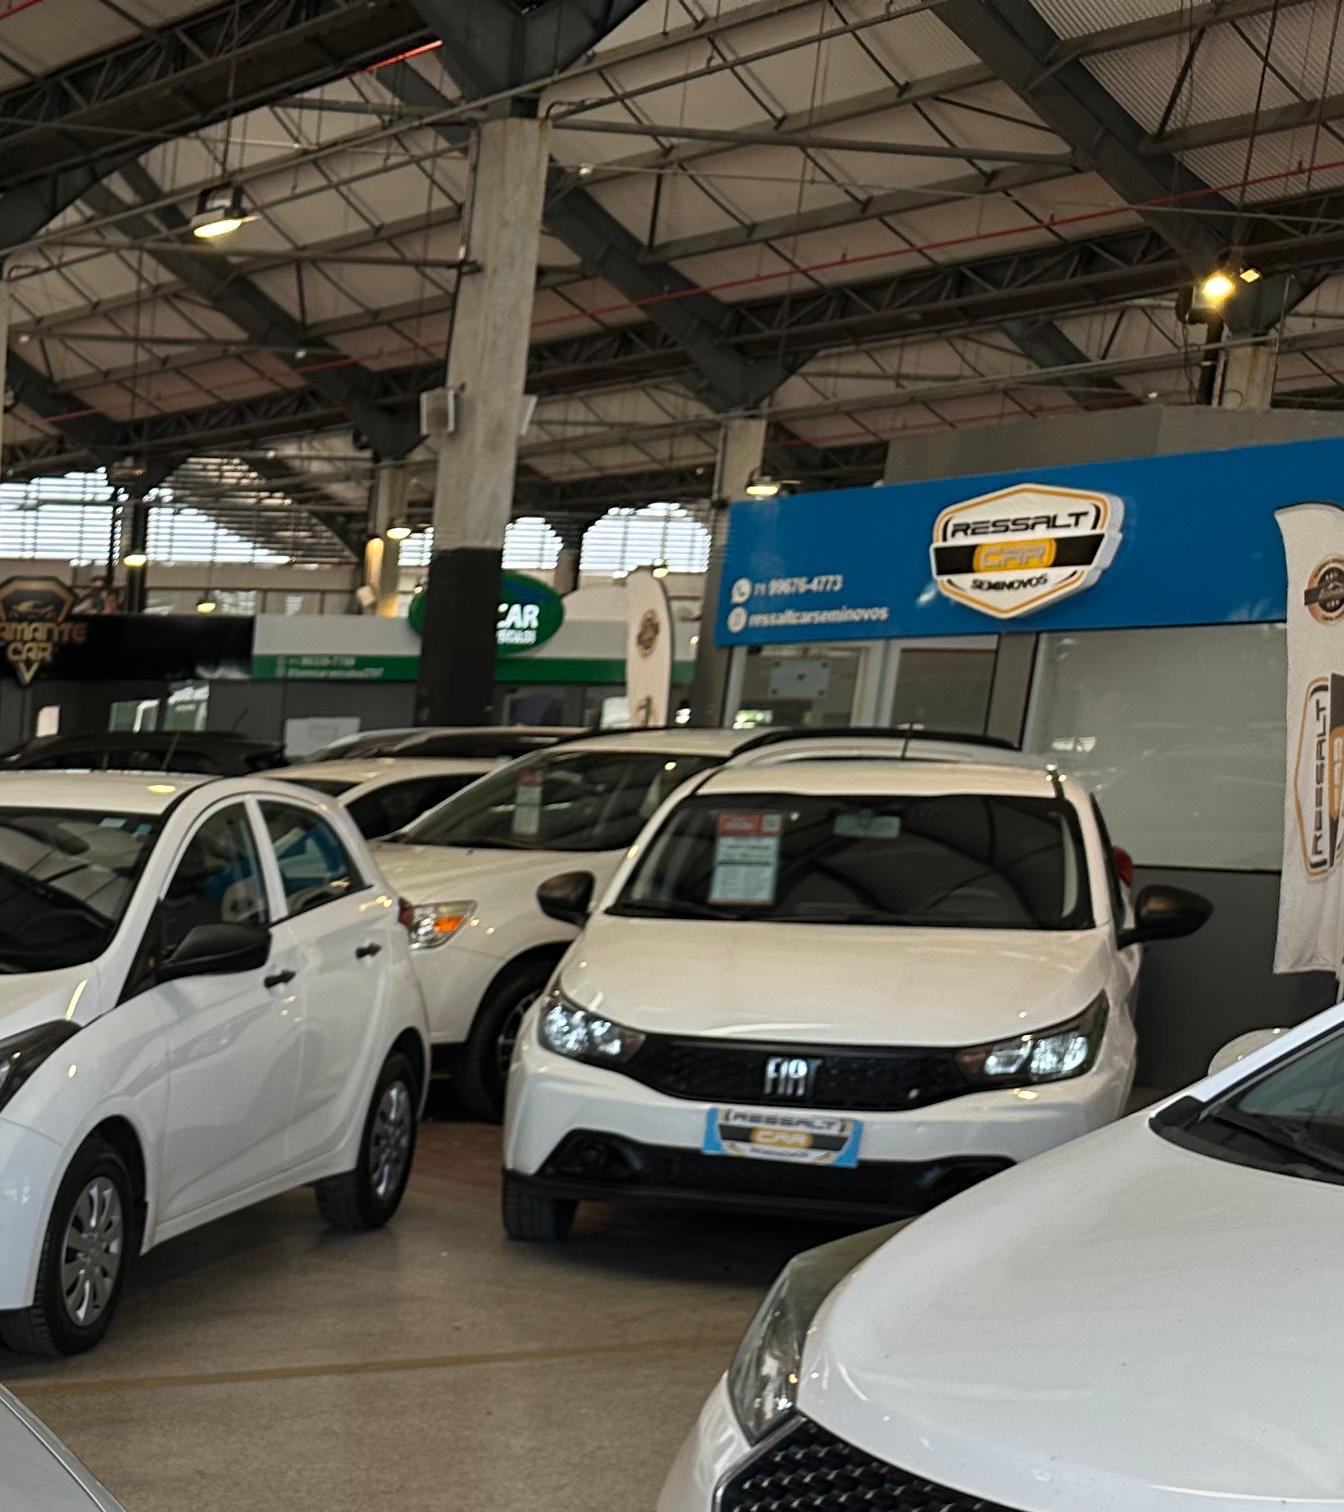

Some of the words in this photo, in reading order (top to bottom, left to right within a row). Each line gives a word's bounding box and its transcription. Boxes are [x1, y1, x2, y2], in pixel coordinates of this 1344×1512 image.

[951, 511, 1090, 538] RESSALT
[980, 543, 1047, 567] CAR
[970, 573, 1049, 592] SEMINOVOS
[6, 641, 54, 663] CAR
[765, 1056, 822, 1097] FIAT
[733, 1112, 837, 1131] RESSALT
